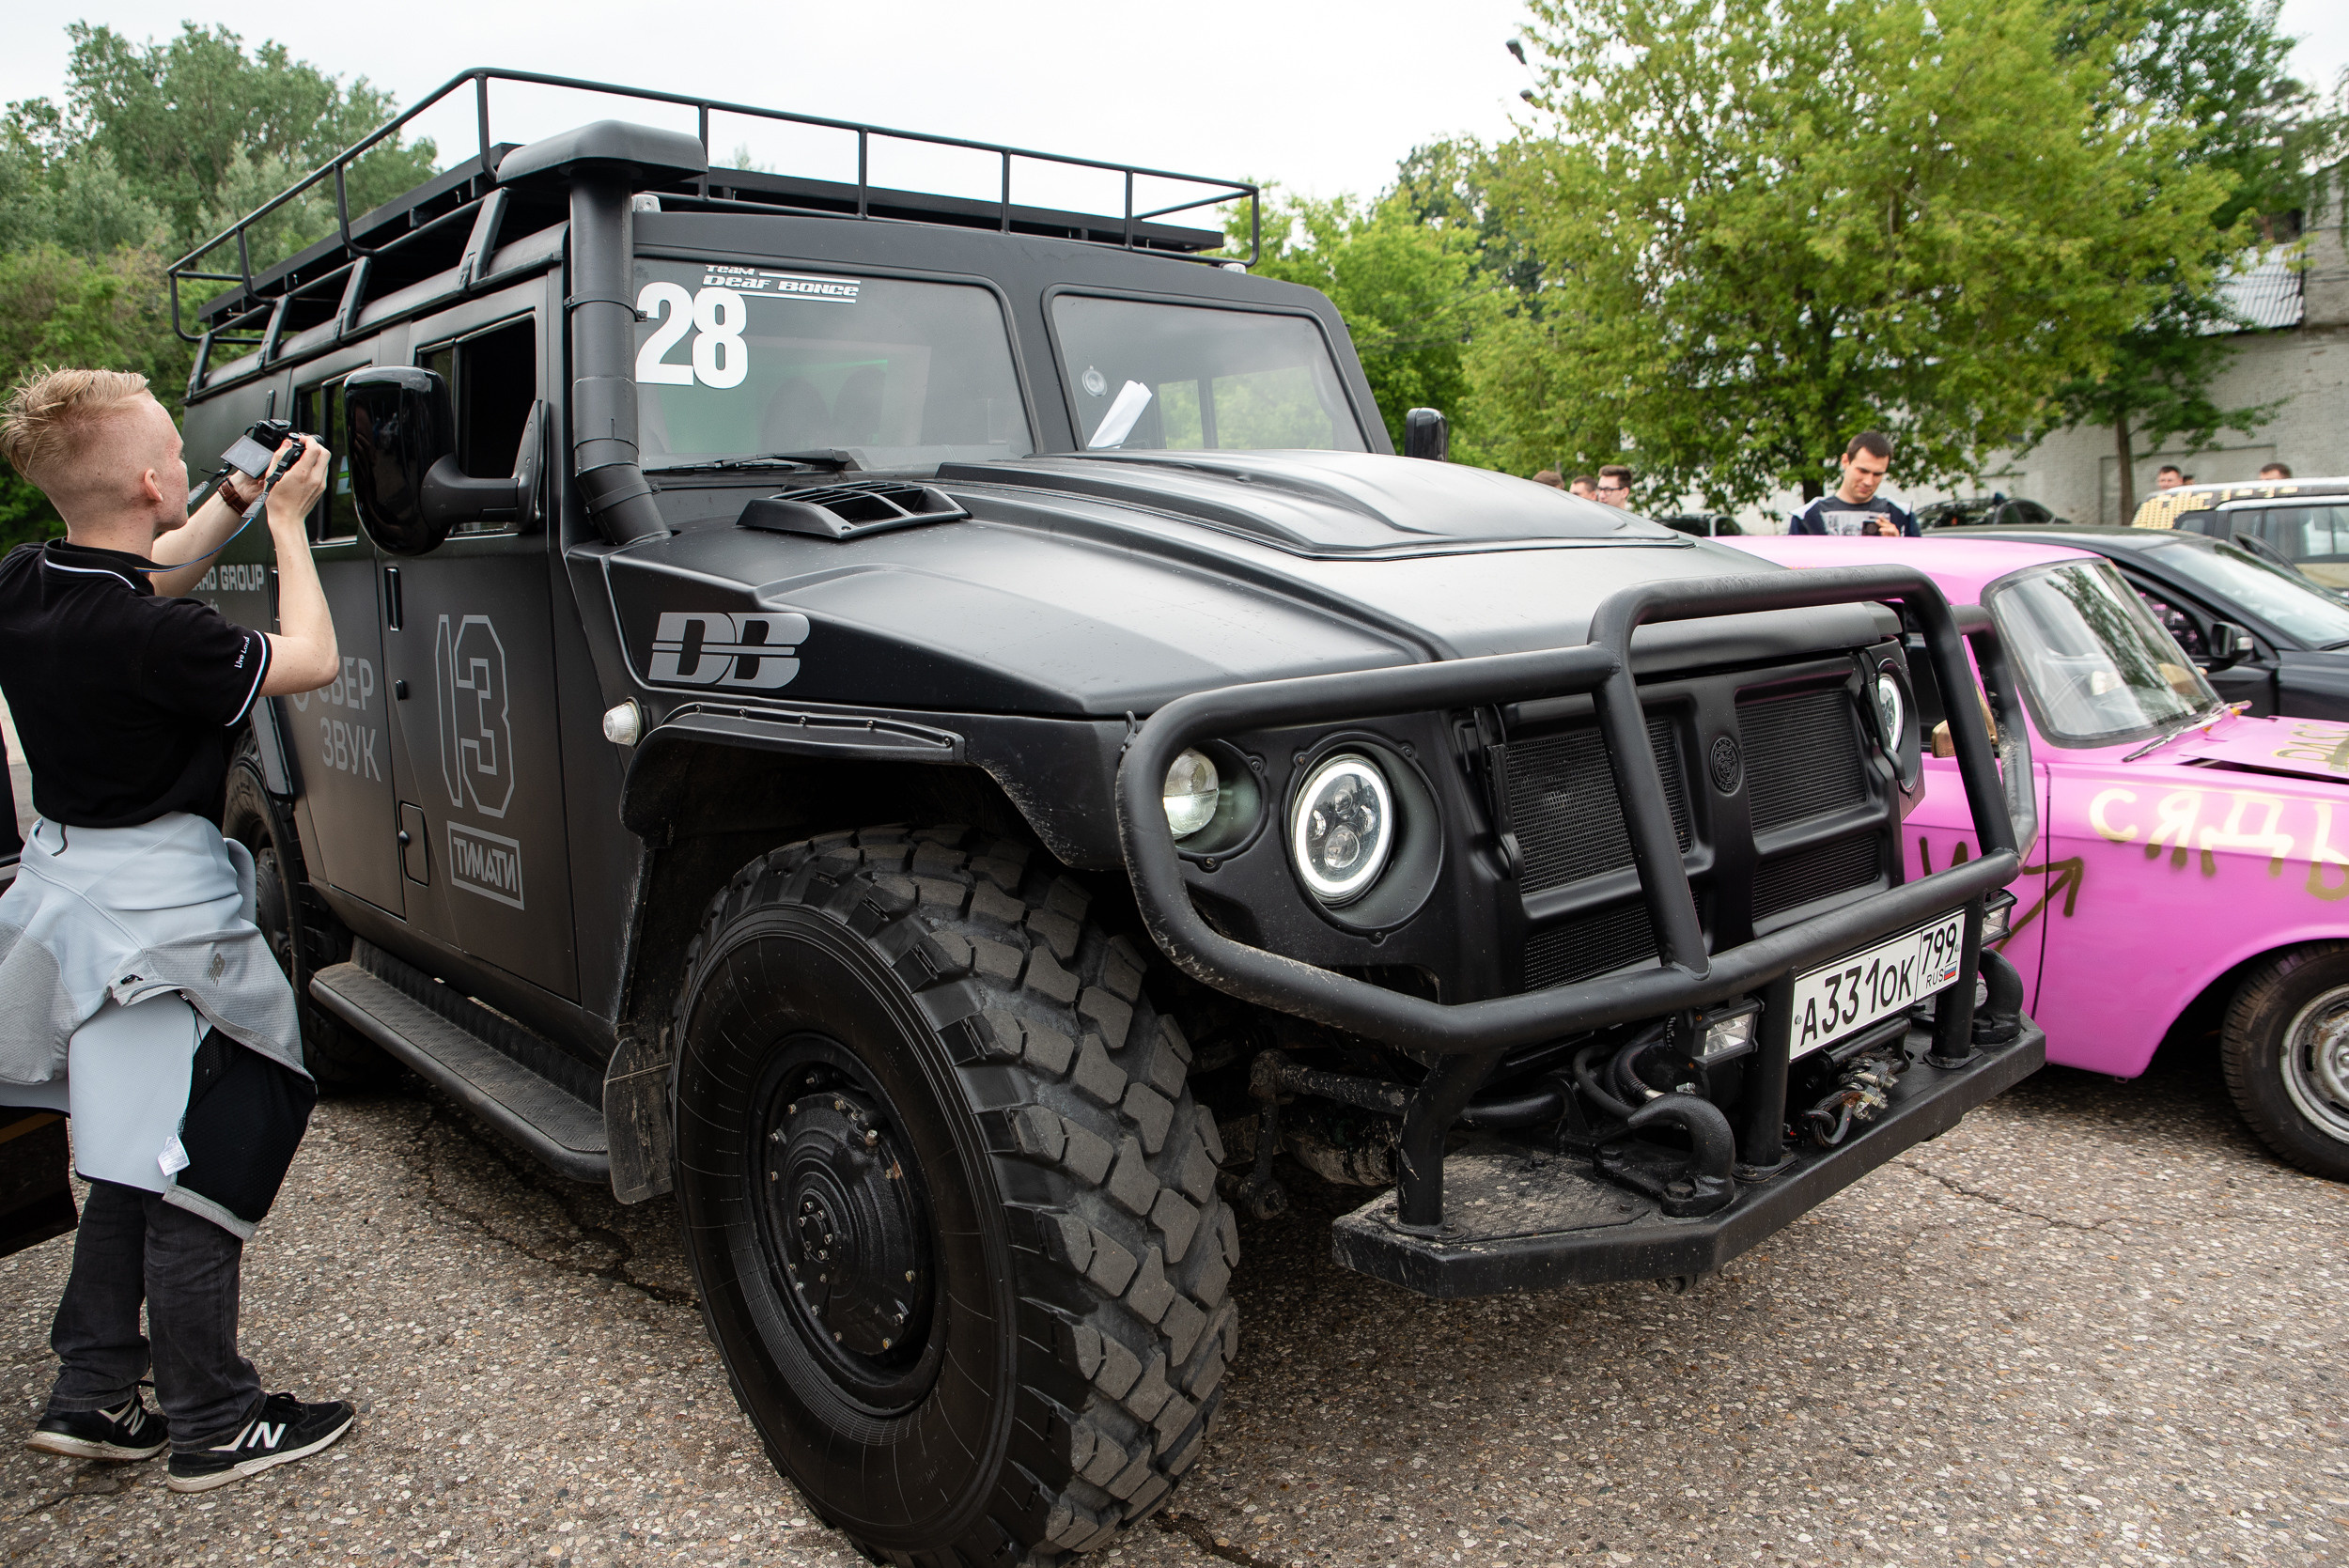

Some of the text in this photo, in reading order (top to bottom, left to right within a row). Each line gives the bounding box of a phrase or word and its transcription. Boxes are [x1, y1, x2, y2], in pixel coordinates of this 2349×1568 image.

[635, 282, 749, 390] 28
[220, 565, 264, 591] GROUP
[648, 612, 810, 689] DB
[435, 614, 515, 818] 13
[320, 717, 381, 782] ЗВУК
[1921, 922, 1957, 976] 799
[1926, 968, 1945, 989] RUS
